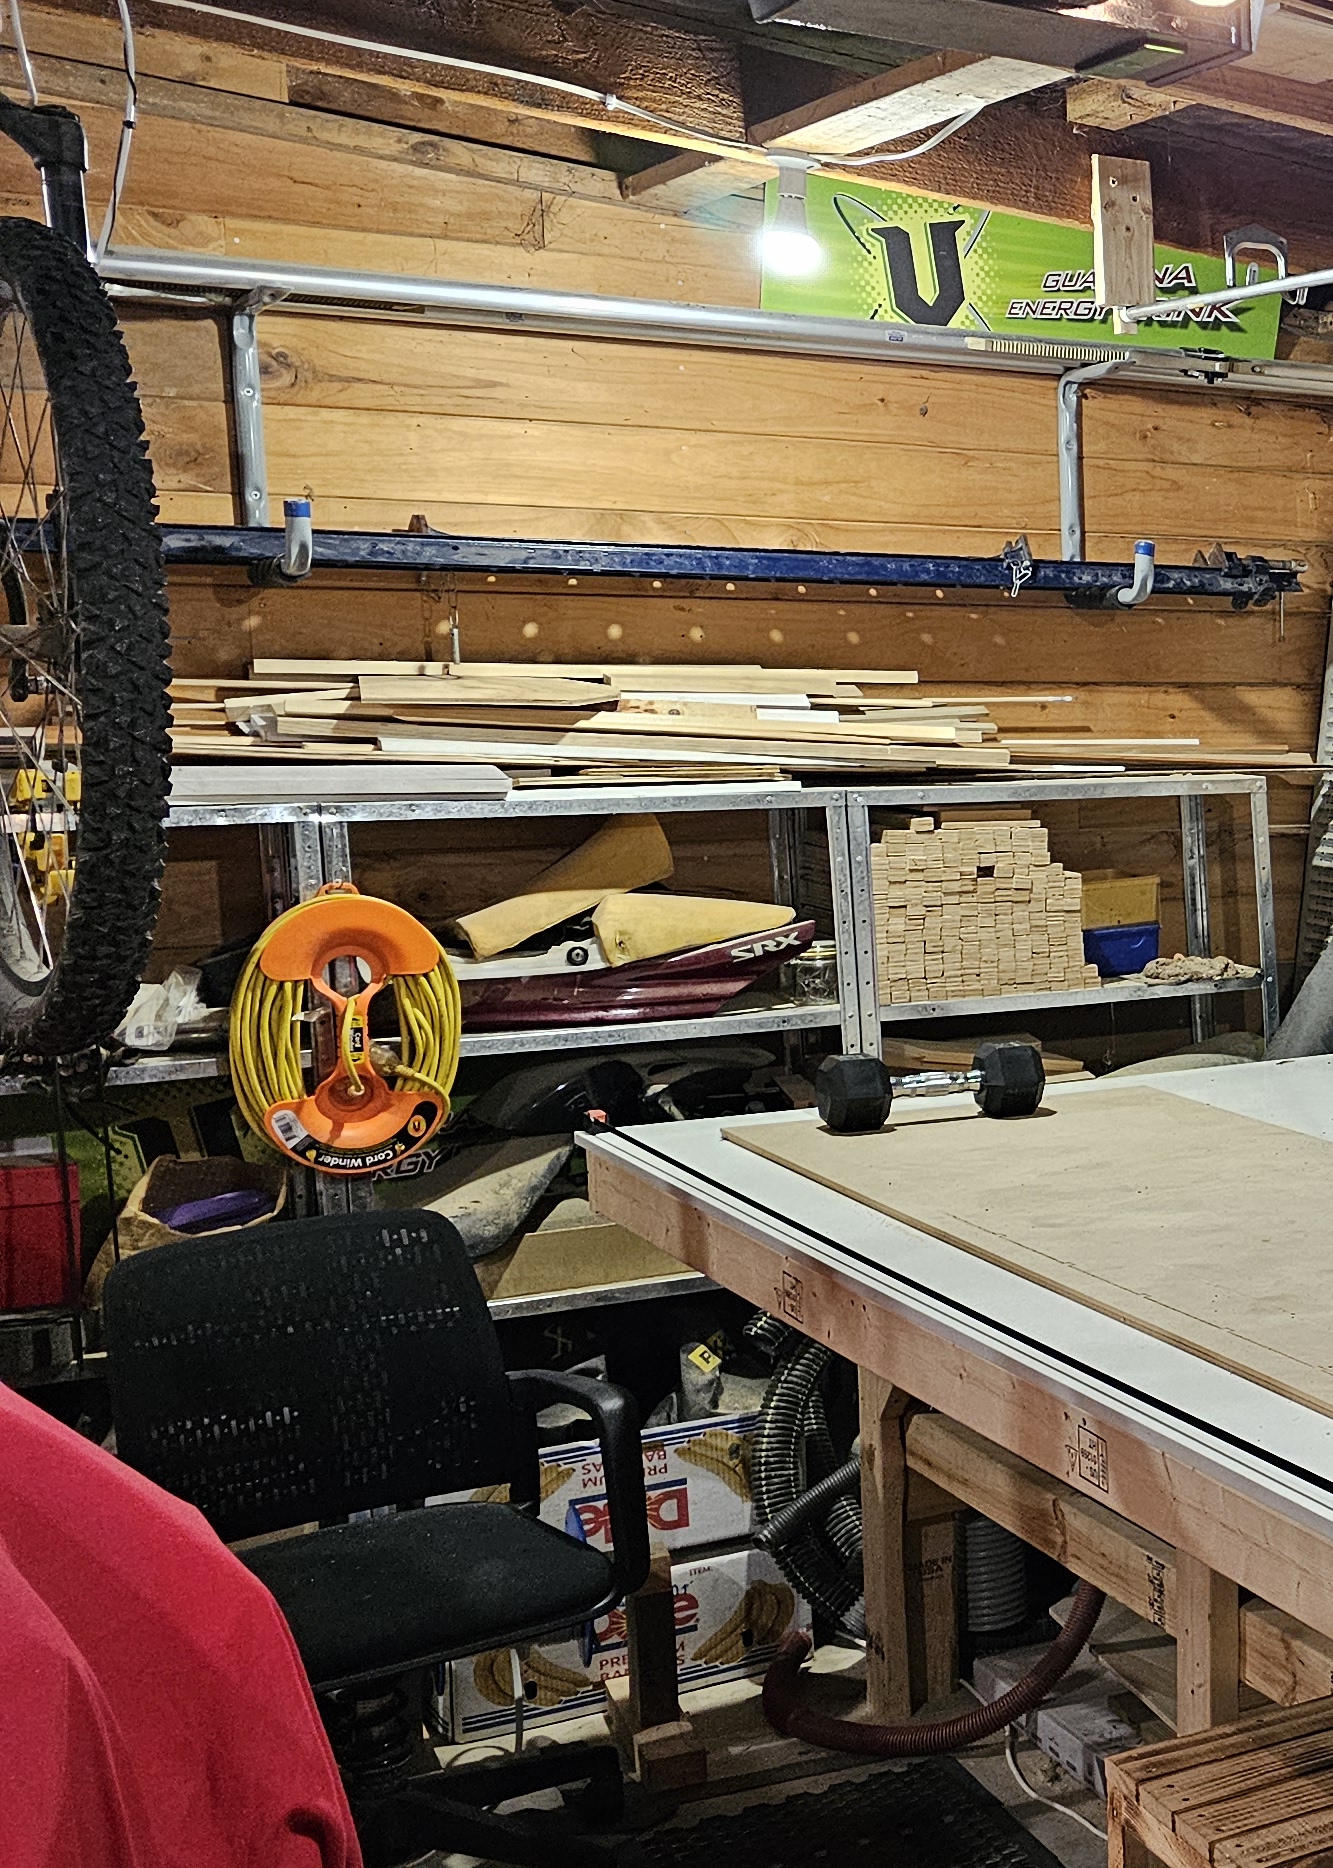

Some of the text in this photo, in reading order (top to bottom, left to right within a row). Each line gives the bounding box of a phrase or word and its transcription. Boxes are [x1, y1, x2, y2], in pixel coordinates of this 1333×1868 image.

[731, 931, 802, 963] SRX
[317, 1150, 394, 1169] Cord Winder
